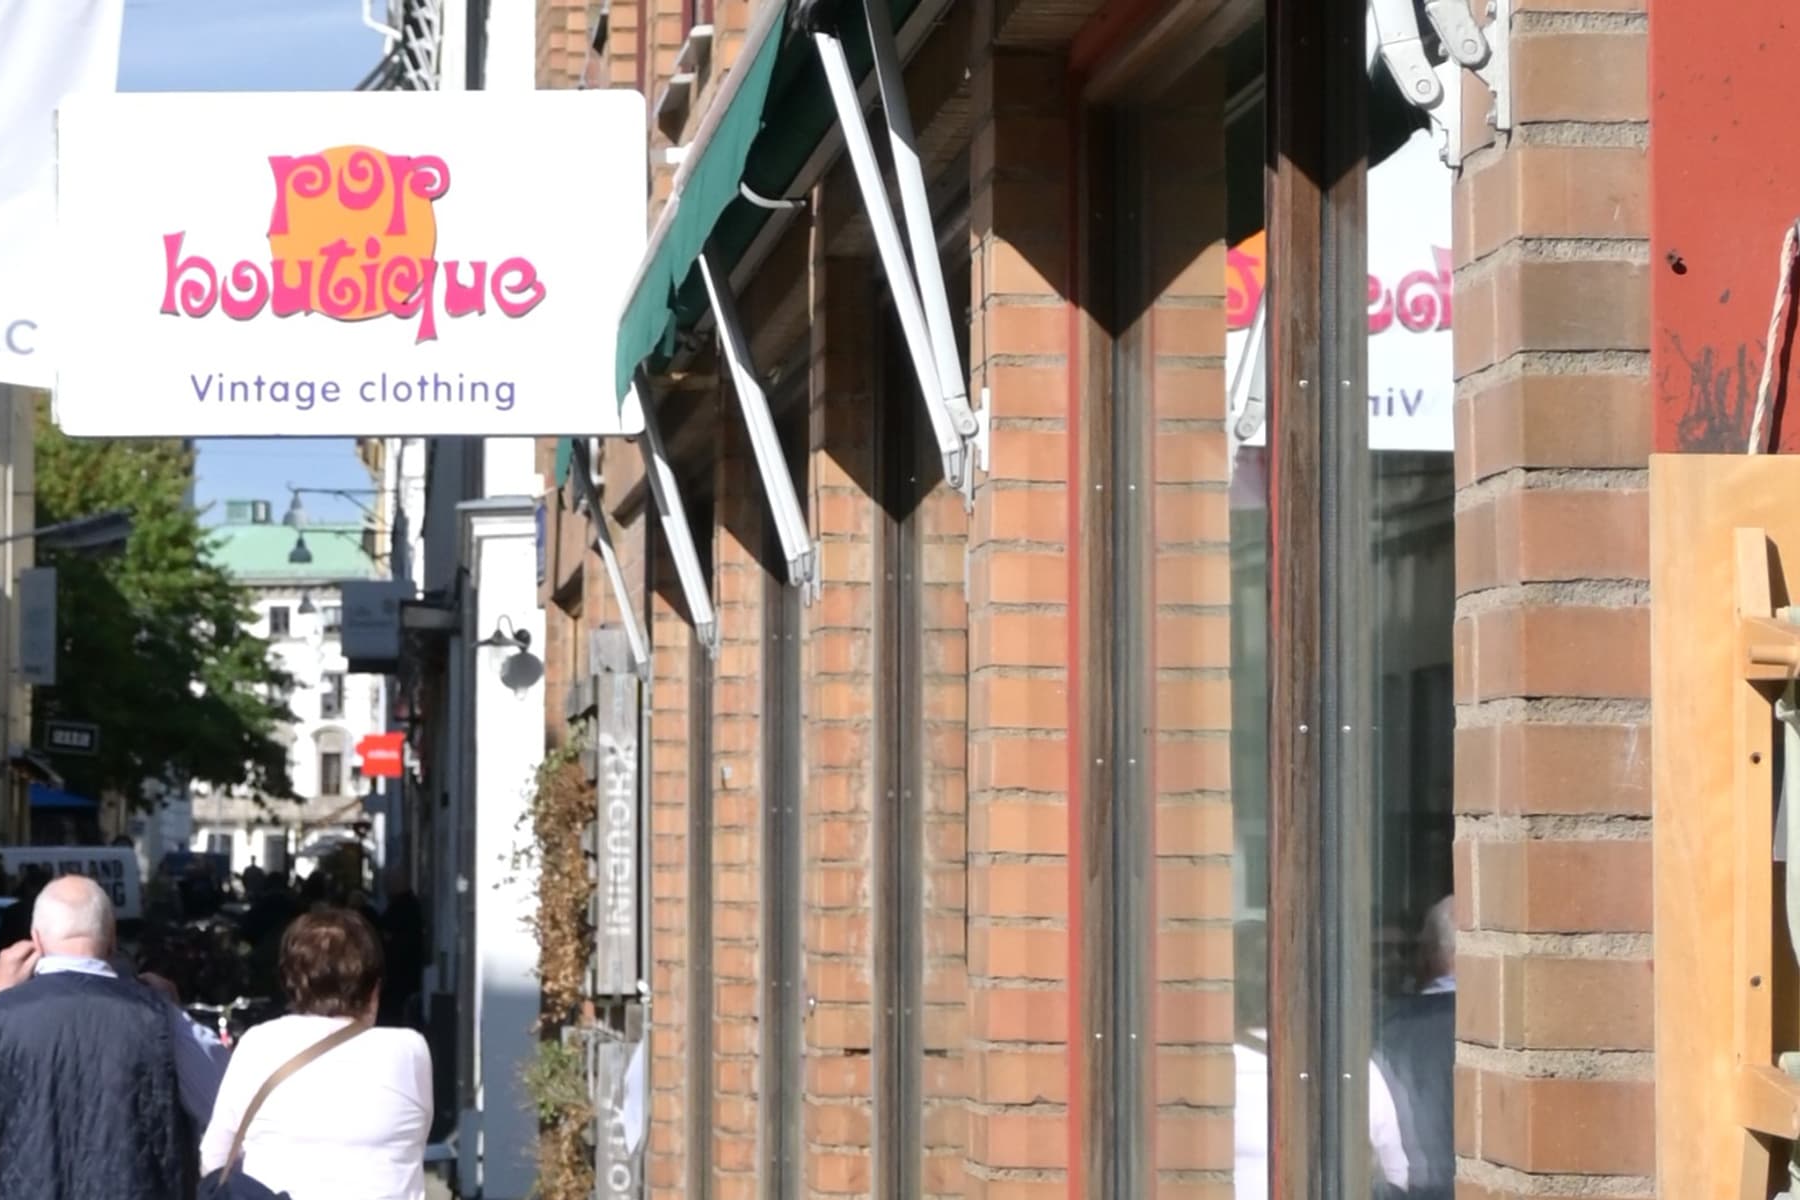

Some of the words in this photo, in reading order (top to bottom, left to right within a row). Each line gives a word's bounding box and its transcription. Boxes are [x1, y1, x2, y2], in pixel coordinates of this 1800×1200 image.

[267, 151, 451, 238] pop
[160, 230, 547, 346] boutique
[190, 373, 341, 411] Vintage
[359, 373, 516, 411] clothing
[604, 773, 635, 937] HOUDINI
